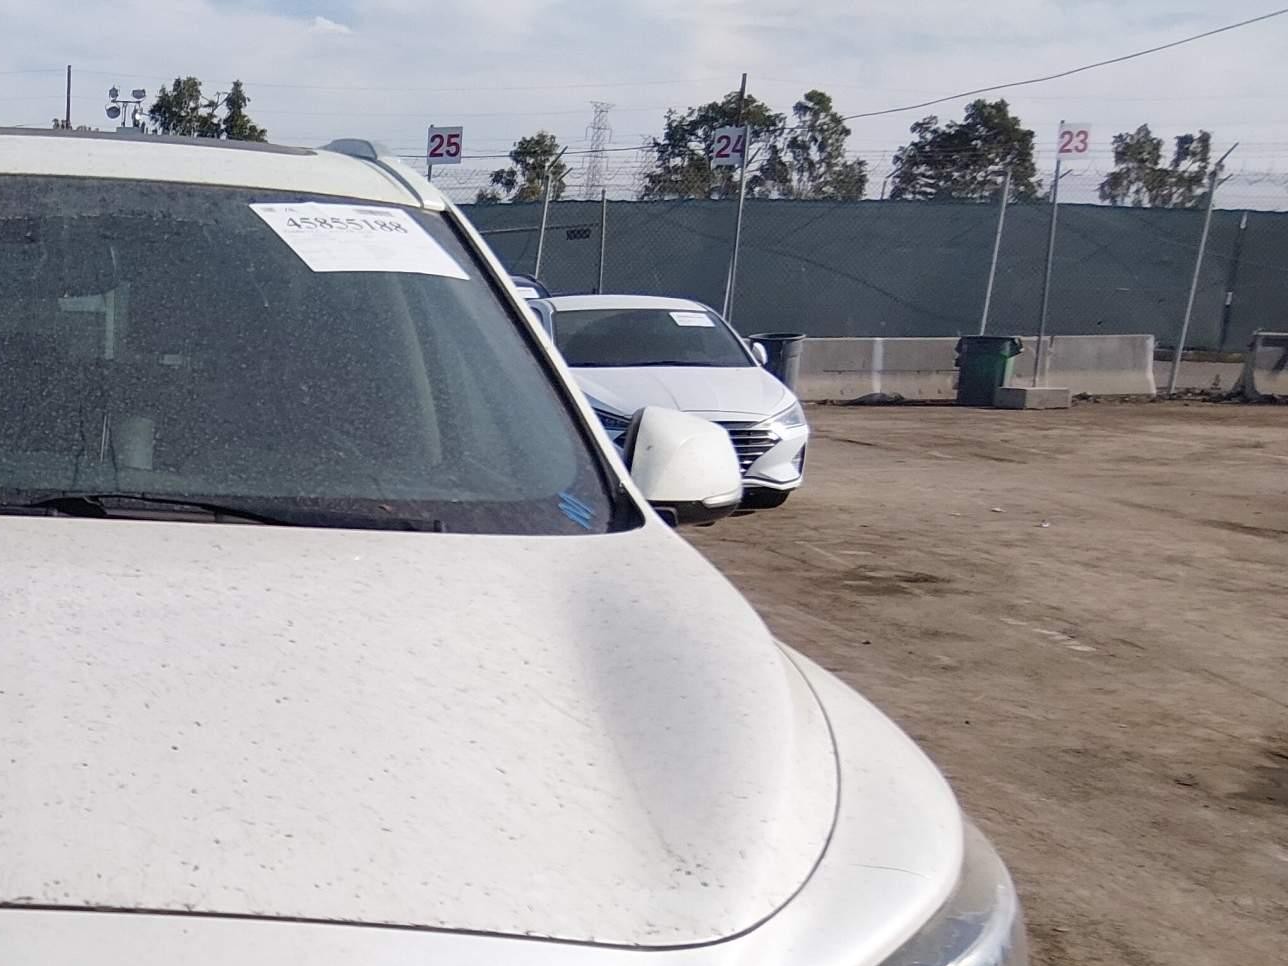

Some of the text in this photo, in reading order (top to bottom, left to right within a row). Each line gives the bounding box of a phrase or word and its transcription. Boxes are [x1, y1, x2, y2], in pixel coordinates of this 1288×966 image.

[429, 133, 461, 158] 25
[715, 134, 745, 159] 24
[1058, 129, 1089, 154] 23
[285, 216, 409, 235] 45855188
